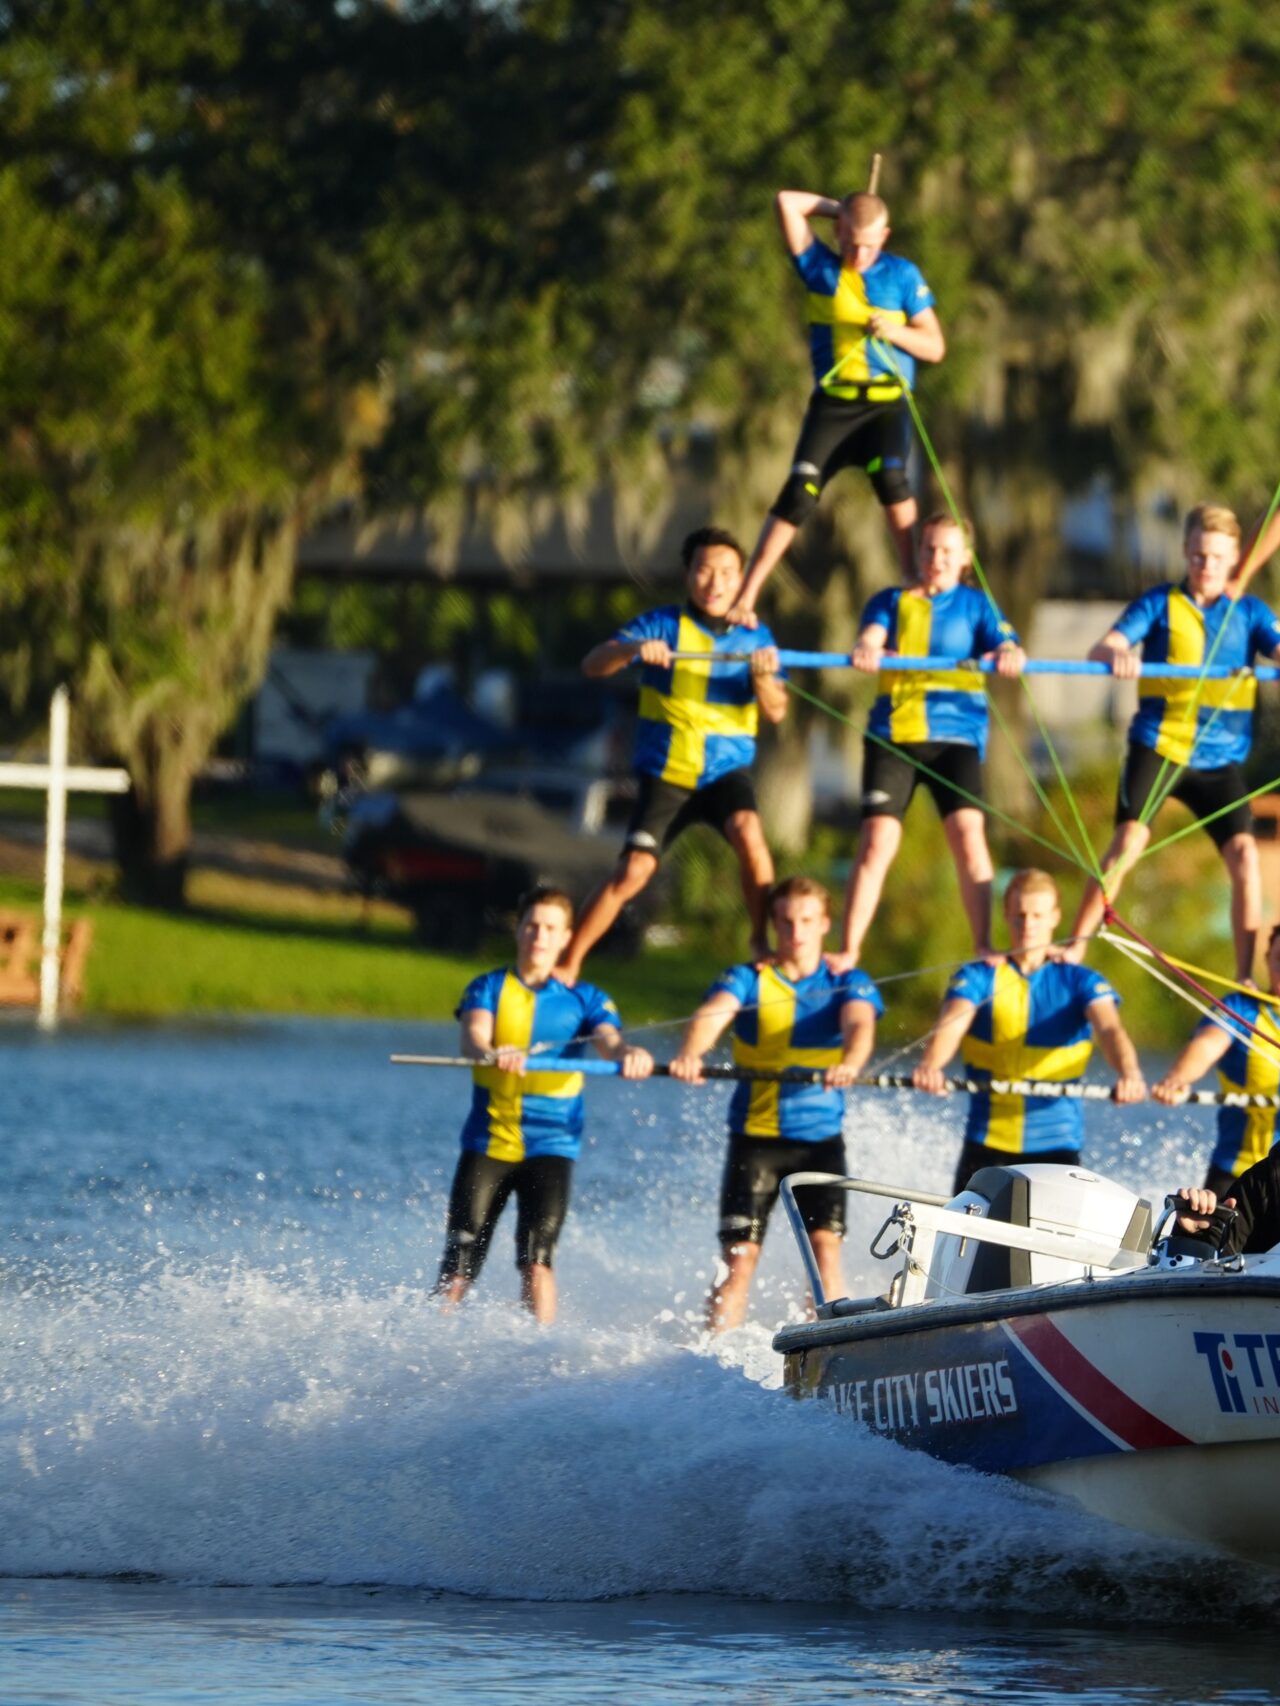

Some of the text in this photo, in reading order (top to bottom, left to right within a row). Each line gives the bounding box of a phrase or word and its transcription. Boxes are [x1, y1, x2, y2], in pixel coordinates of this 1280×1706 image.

[811, 1360, 1018, 1431] AKE CITY SKIERS
